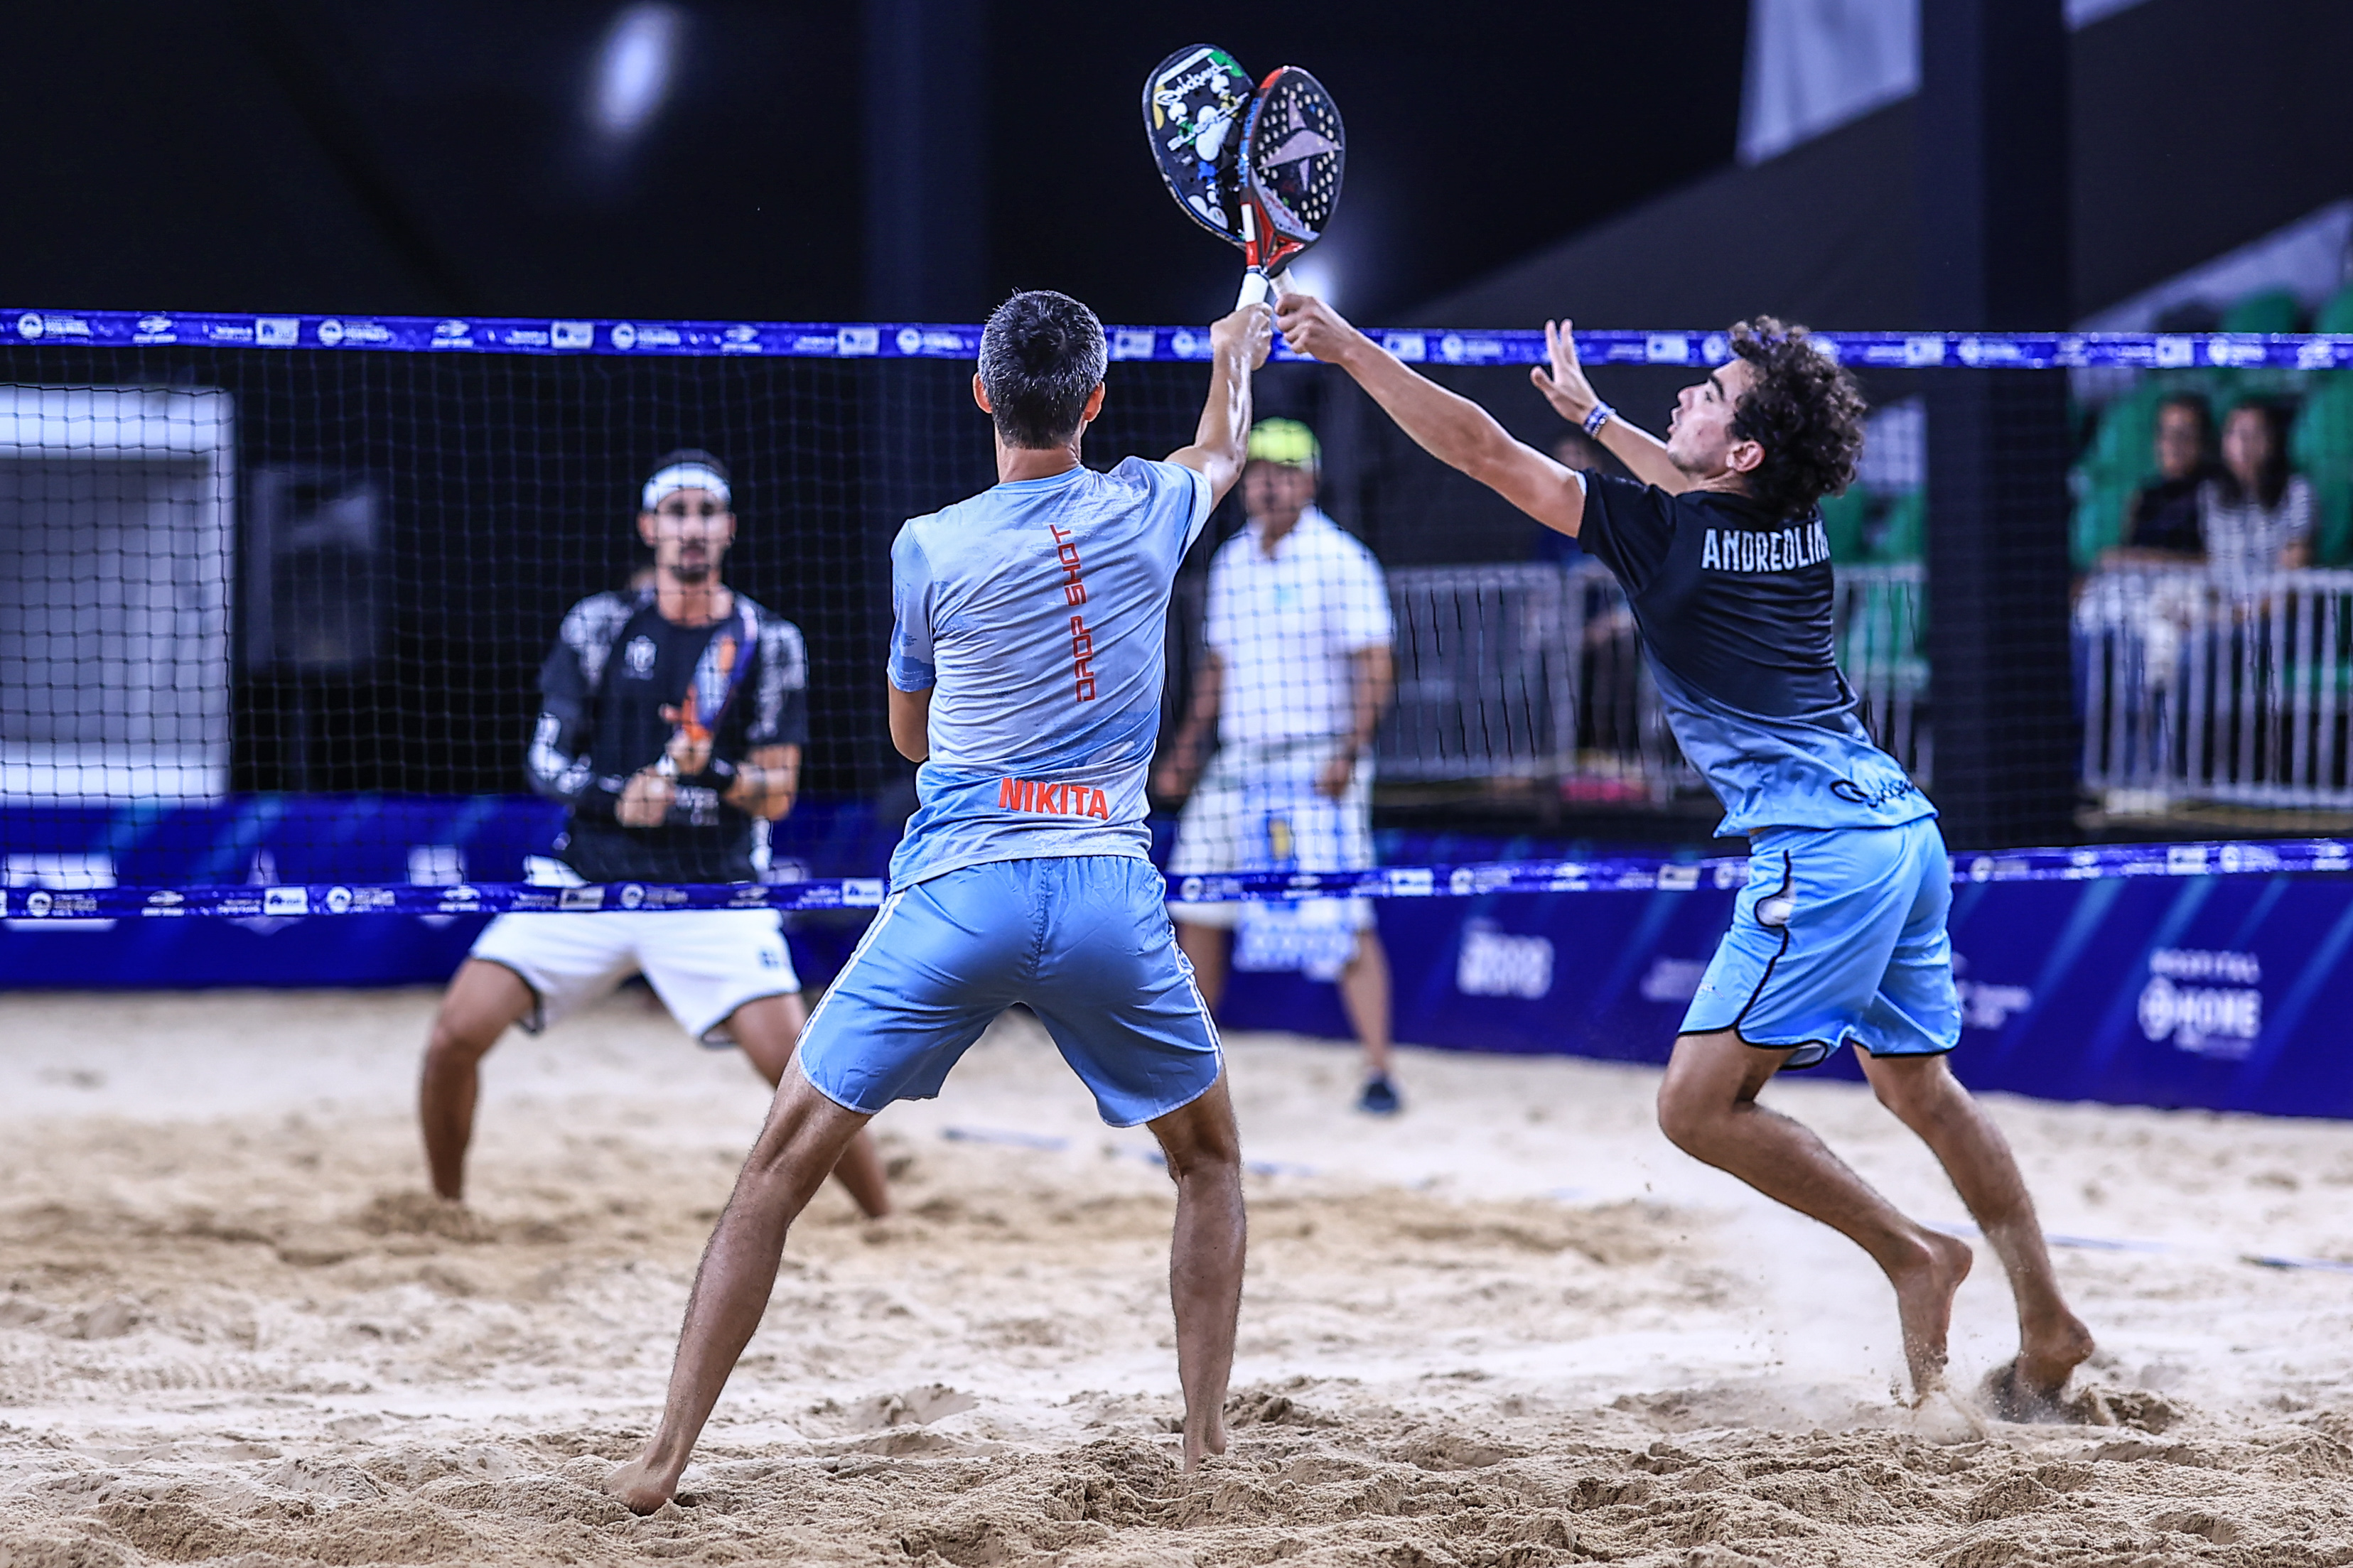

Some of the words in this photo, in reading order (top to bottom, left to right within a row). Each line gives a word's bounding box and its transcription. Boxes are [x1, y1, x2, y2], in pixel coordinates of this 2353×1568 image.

[1049, 524, 1087, 606] SHOT
[1070, 615, 1096, 702] DROP
[998, 777, 1109, 821] NIKITA
